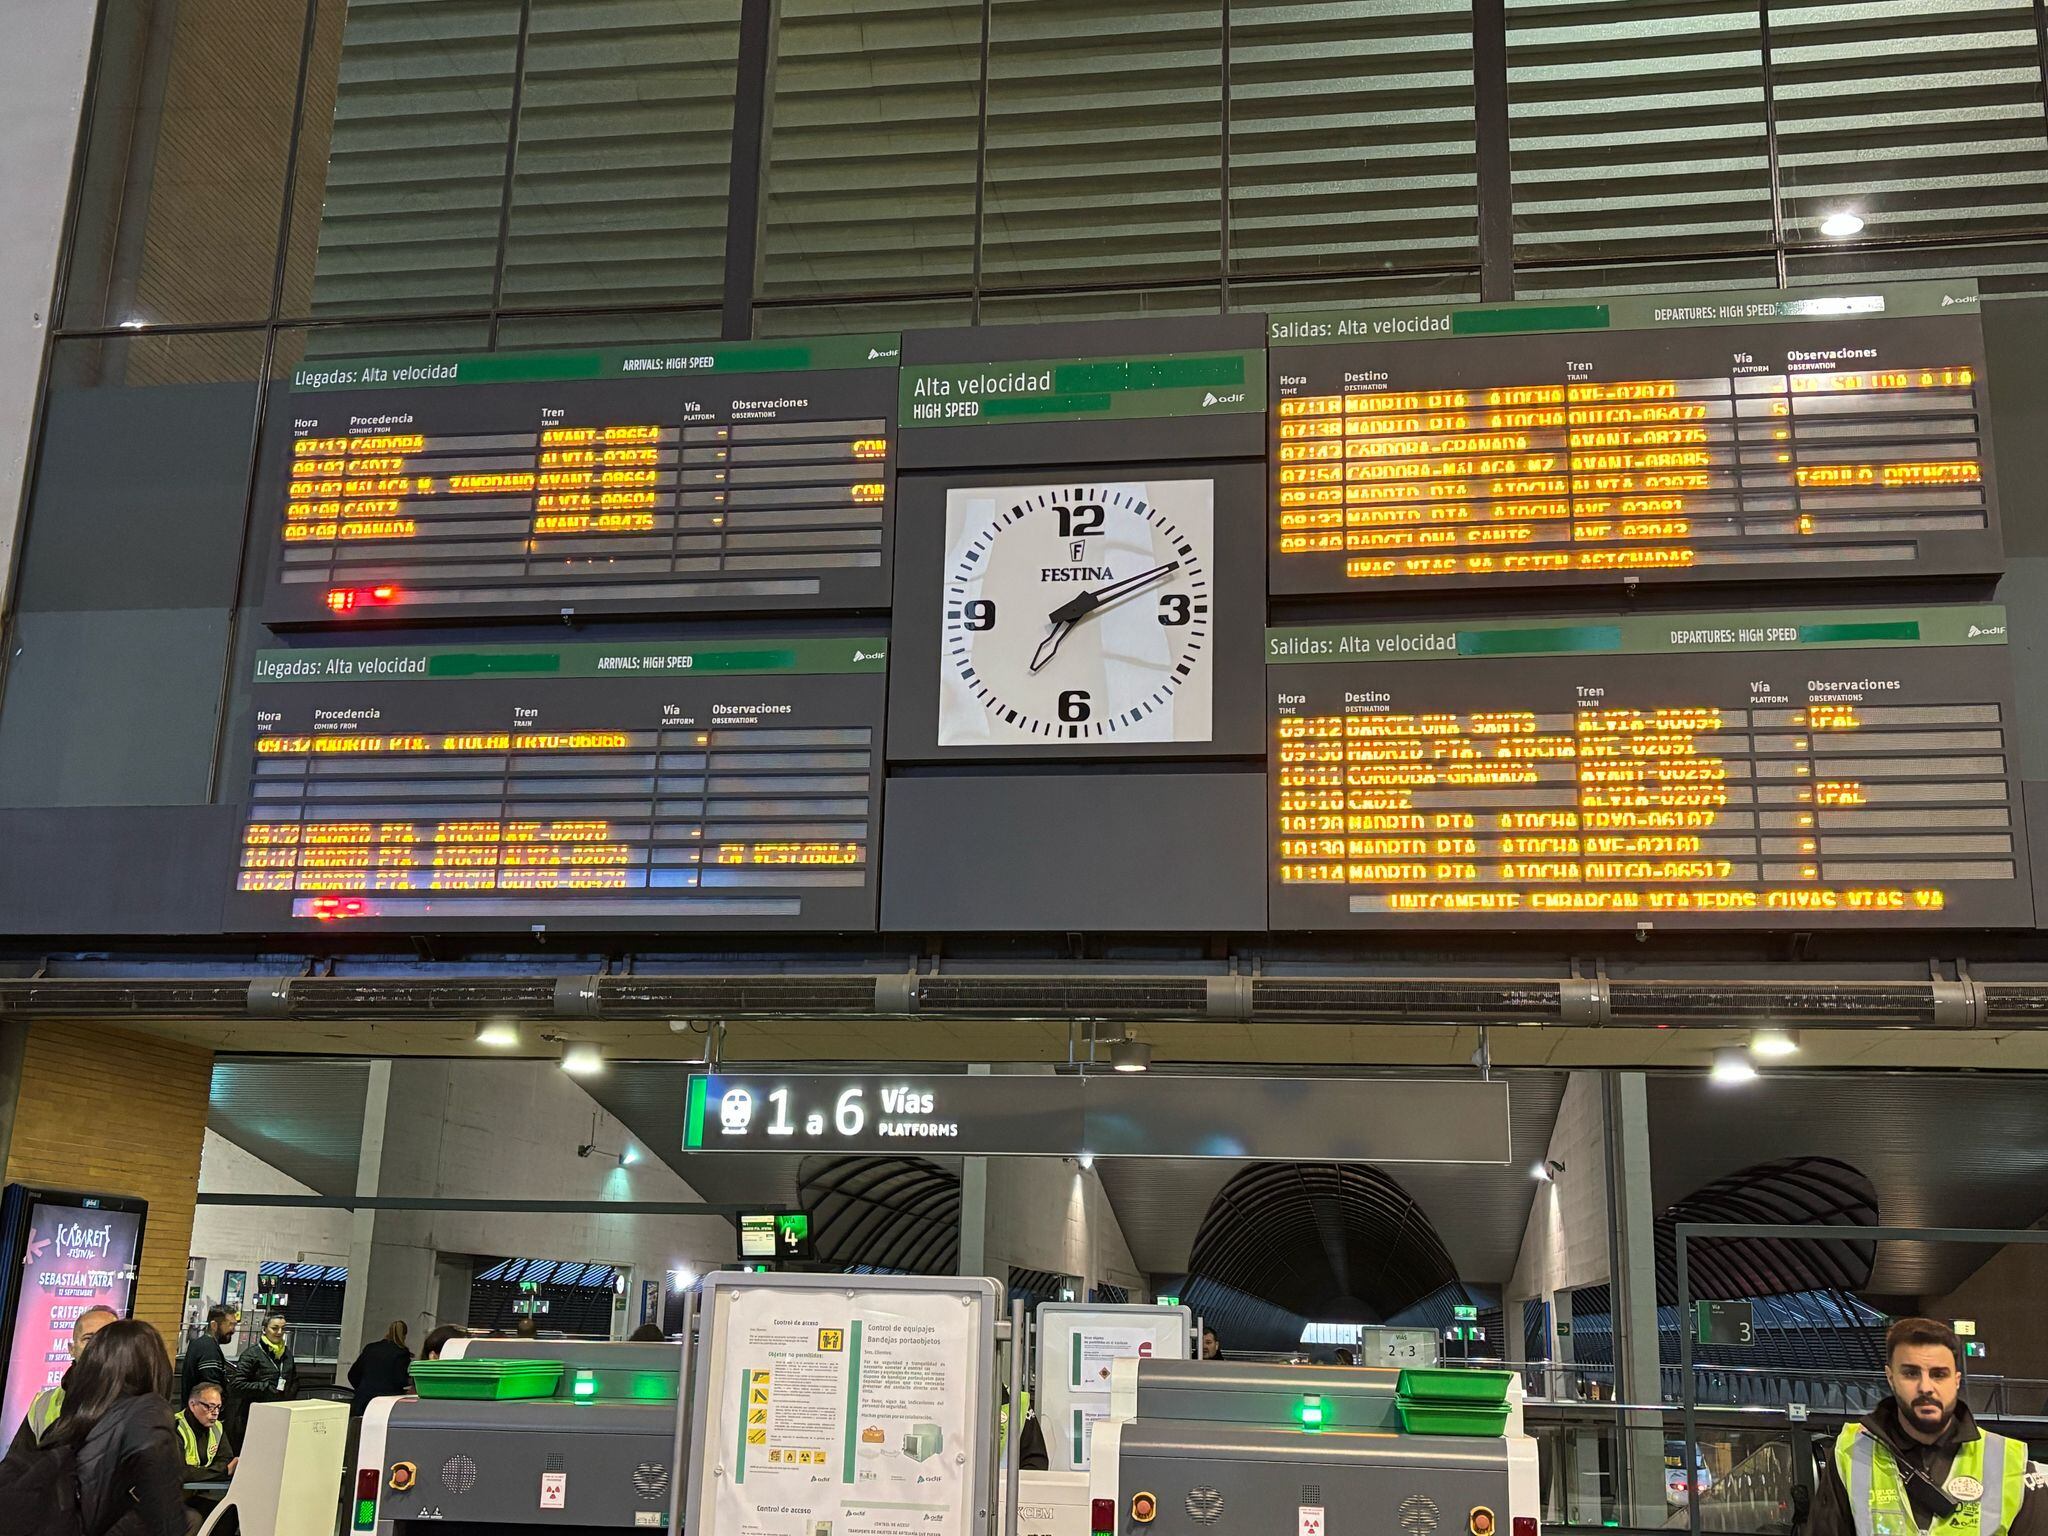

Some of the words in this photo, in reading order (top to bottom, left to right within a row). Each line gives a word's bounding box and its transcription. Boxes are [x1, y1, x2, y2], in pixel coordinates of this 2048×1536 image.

[1954, 294, 1979, 307] adif
[1654, 305, 1717, 321] DEPARTURES:
[1720, 304, 1743, 319] HIGH
[1746, 303, 1777, 318] SPEED
[1272, 317, 1333, 338] Salidas:
[1338, 318, 1367, 336] Alta
[1371, 314, 1451, 334] velocidad
[879, 348, 899, 359] adif
[1734, 352, 1753, 364] Vía
[1787, 348, 1878, 362] Observaciones
[623, 357, 664, 372] ARRIVALS:
[666, 356, 688, 370] HIGH
[690, 355, 714, 370] SPEED
[1567, 361, 1593, 371] Tren
[1733, 365, 1769, 374] PLATFORM
[1787, 362, 1836, 371] OBSERVATION
[295, 367, 358, 387] Llegadas:
[361, 367, 390, 384] Alta
[393, 363, 458, 382] velocidad
[1280, 375, 1307, 385] Hora
[1344, 371, 1388, 382] Destino
[1567, 373, 1588, 381] TRAIN
[914, 376, 950, 397] Alta
[957, 371, 1051, 395] velocidad
[1218, 392, 1246, 403] adif
[685, 401, 701, 412] Vía
[732, 398, 808, 411] Observaciones
[913, 403, 941, 419] HIGH
[944, 401, 979, 418] SPEED
[541, 408, 564, 418] Tren
[684, 413, 715, 421] PLATFORM
[732, 410, 776, 419] OBSERVATIONS
[294, 419, 318, 428] Hora
[350, 413, 413, 426] Procedencia
[1052, 504, 1105, 538] 12
[1041, 566, 1114, 582] FESTINA
[963, 600, 996, 631] 9
[1158, 594, 1191, 626] 3
[1670, 629, 1736, 644] DEPARTURES:
[1739, 628, 1763, 643] HIGH
[1766, 627, 1798, 642] SPEED
[1983, 625, 2006, 636] adif
[1270, 635, 1334, 656] Salidas:
[1338, 637, 1370, 654] Alta
[1375, 632, 1457, 653] velocidad
[865, 651, 884, 661] adif
[257, 657, 322, 678] Llegadas:
[326, 658, 354, 675] Alta
[358, 656, 426, 674] velocidad
[598, 656, 640, 670] ARRIVALS:
[643, 655, 667, 670] HIGH
[669, 655, 693, 669] SPEED
[1577, 686, 1604, 696] Tren
[1750, 681, 1770, 692] Vía
[1807, 679, 1900, 692] Observaciones
[1278, 694, 1306, 704] Hora
[1345, 692, 1390, 702] Destino
[1750, 695, 1788, 703] PLATFORM
[1809, 694, 1863, 702] OBSERVATIONS
[514, 707, 538, 717] Tren
[663, 704, 680, 715] Vía
[712, 703, 792, 715] Observaciones
[1058, 690, 1091, 722] 6
[257, 711, 281, 721] Hora
[315, 708, 380, 720] Procedencia
[880, 1087, 934, 1116] Vías
[767, 1089, 793, 1136] 1
[806, 1113, 822, 1135] a
[835, 1088, 865, 1136] 6
[878, 1121, 958, 1138] PLATFORMS
[784, 1226, 799, 1246] 4
[39, 1271, 86, 1287] SEBASTIÁN
[88, 1272, 113, 1287] YATRA
[868, 1324, 891, 1332] Control
[903, 1325, 935, 1334] equipajes
[1740, 1322, 1751, 1341] 3
[867, 1336, 897, 1345] Bandejas
[899, 1336, 941, 1346] portaobjetos
[1388, 1345, 1395, 1356] 2
[1409, 1345, 1416, 1357] 3
[757, 1505, 779, 1513] Control
